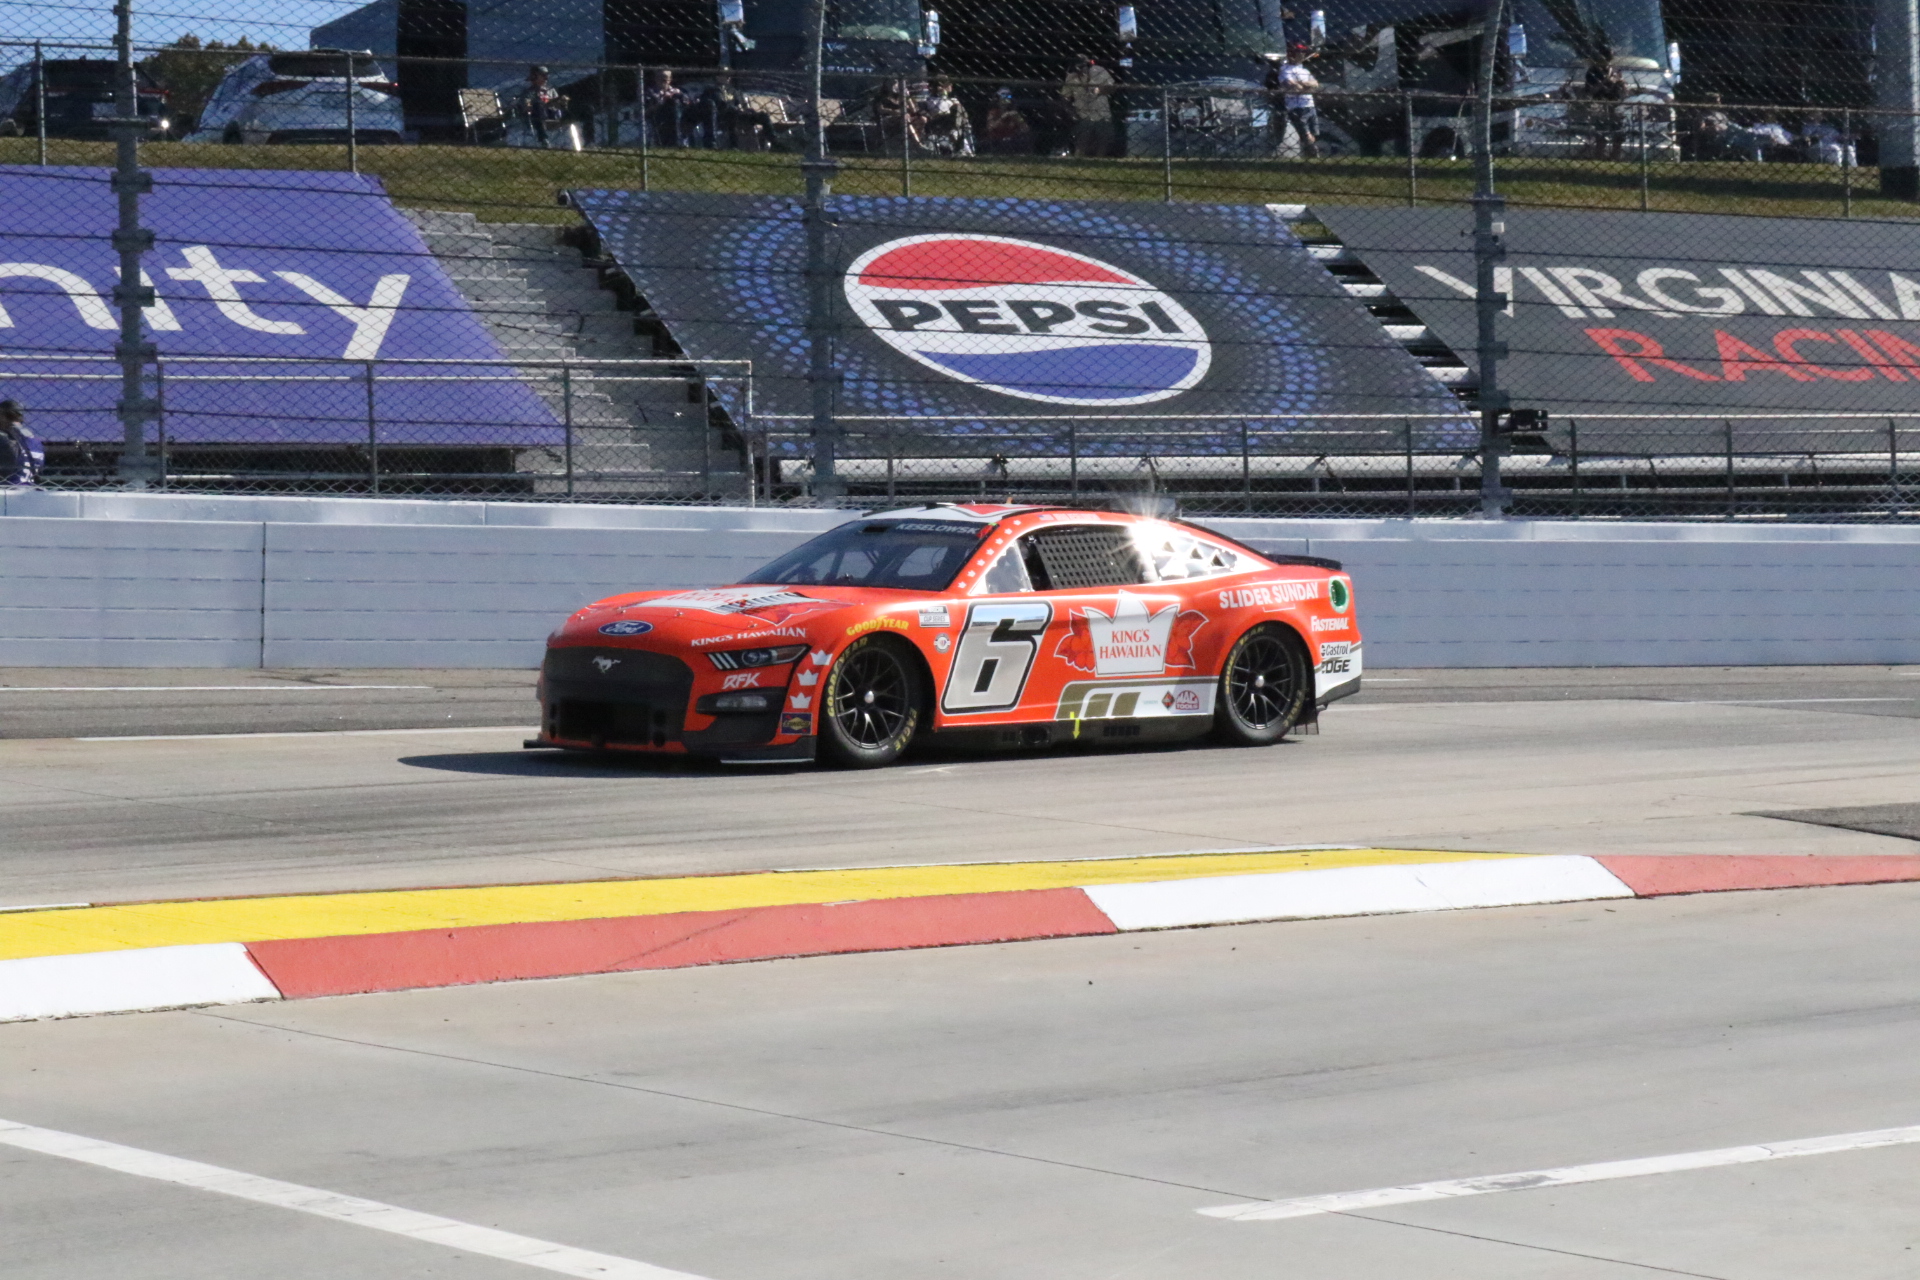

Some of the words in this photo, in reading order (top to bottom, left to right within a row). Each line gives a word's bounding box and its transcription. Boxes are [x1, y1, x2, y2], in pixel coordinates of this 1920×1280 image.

[869, 299, 1185, 335] PEPSI
[1219, 587, 1273, 609] SLIDER
[1272, 582, 1319, 603] SUNDAY
[604, 621, 645, 634] Ford
[846, 615, 909, 636] GOODYEAR
[737, 627, 806, 640] HAWAIIAN
[1111, 628, 1150, 643] KING'S
[1099, 644, 1162, 659] HAWAIIAN
[1326, 643, 1349, 656] Castrol
[941, 599, 1054, 716] 6
